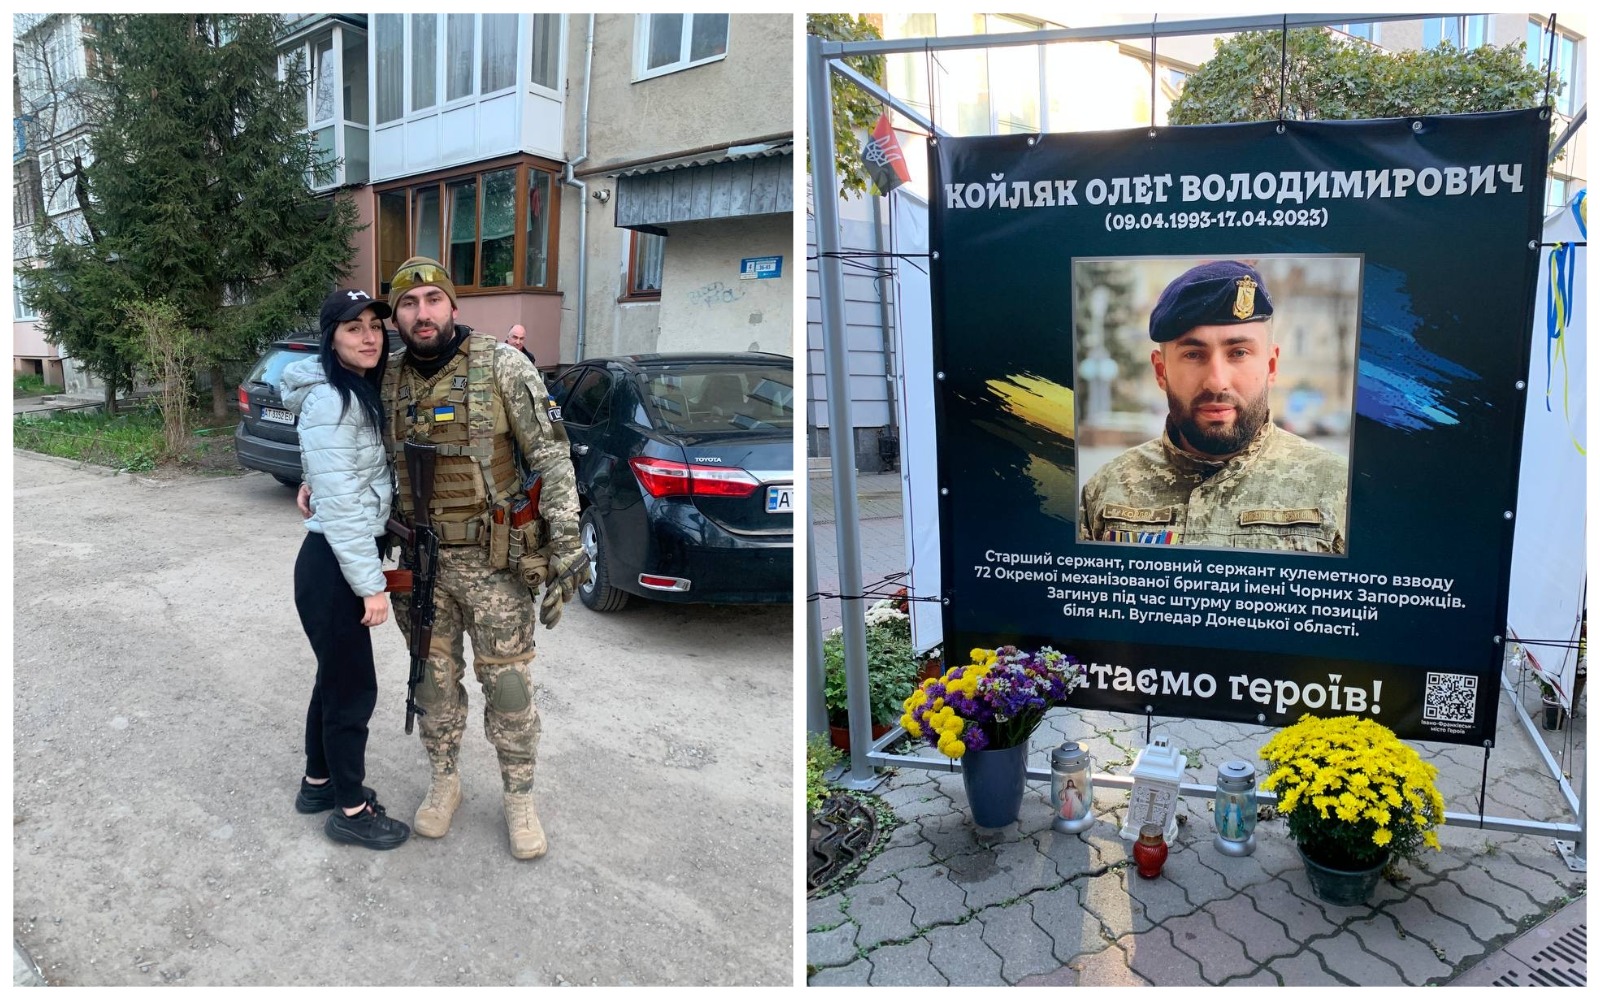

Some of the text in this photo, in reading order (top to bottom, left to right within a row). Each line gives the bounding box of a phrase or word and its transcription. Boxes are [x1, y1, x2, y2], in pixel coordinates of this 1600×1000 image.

[944, 164, 1524, 208] КОЙЛЯК ОЛЕГ ВОЛОДИМИРОВИЧ
[1106, 208, 1329, 232] (09.04.1993-17.04.2023)
[974, 566, 1466, 609] 72 Окремої механізованої бригади імені Чорних Запорожців.
[985, 550, 1454, 592] Старший сержант, головний сержант кулеметного взводу
[1047, 587, 1379, 621] Загинув під час штурму ворожих позицій
[1063, 604, 1361, 637] біля н.п. Вугледар Донецької області.
[1229, 673, 1383, 715] героїв!
